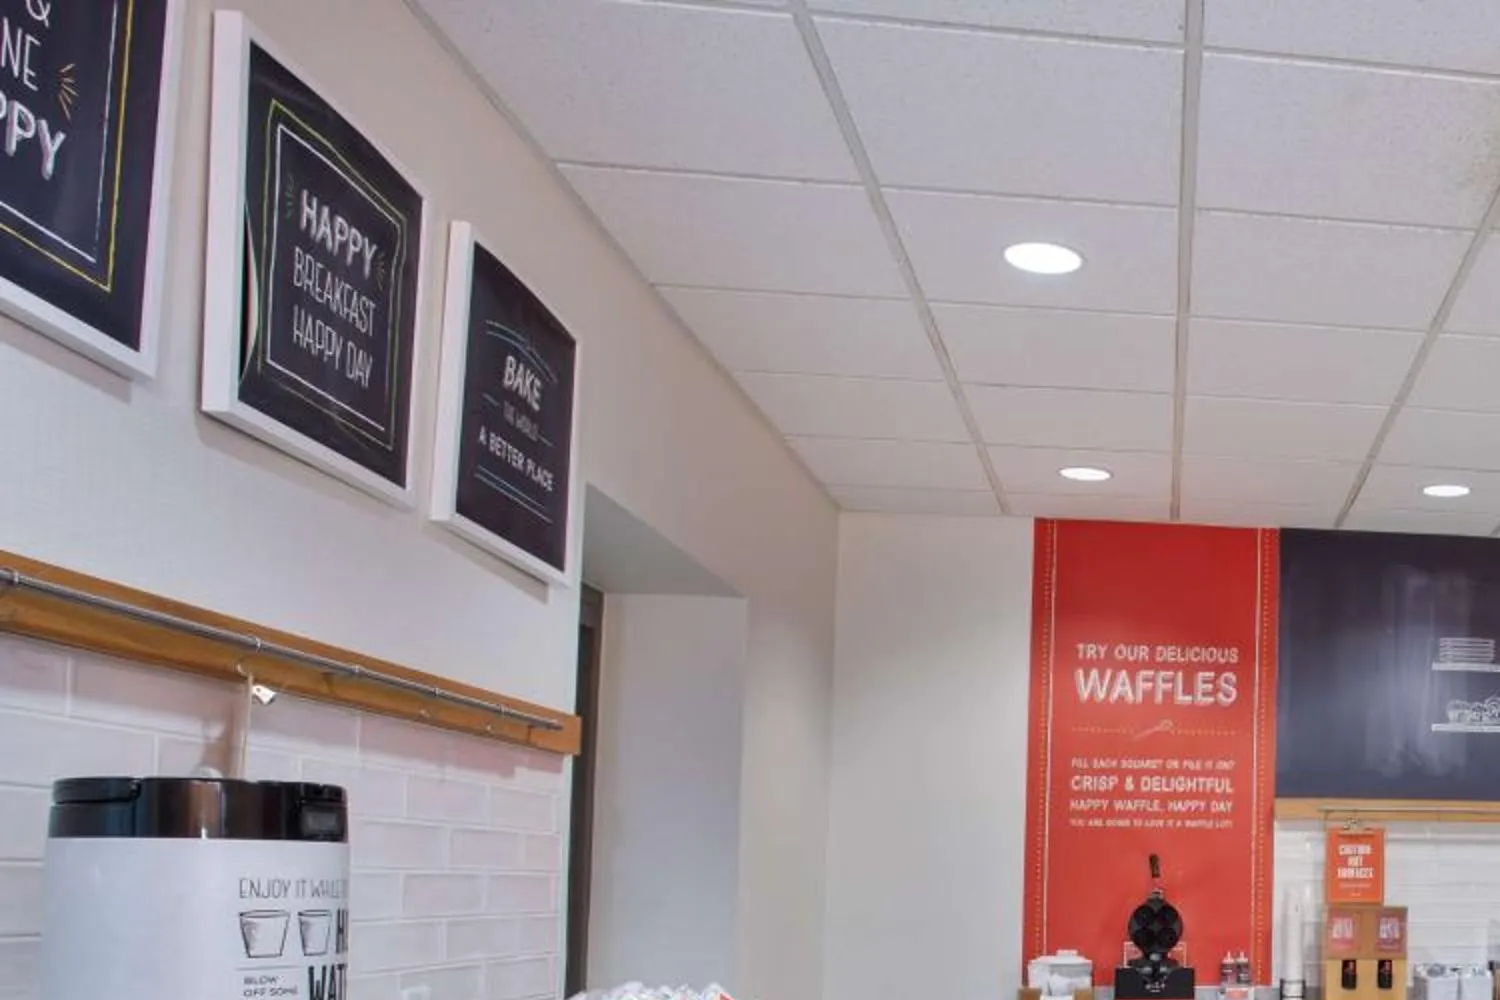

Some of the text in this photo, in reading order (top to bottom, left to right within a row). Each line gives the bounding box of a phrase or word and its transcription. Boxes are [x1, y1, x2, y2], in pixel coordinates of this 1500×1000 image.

[300, 188, 377, 280] HAPPY
[293, 246, 376, 337] BREAKFAST
[293, 304, 373, 388] HAPPY DAY
[503, 355, 542, 412] BAKE
[479, 425, 554, 492] A BETTER PLACE
[1077, 643, 1239, 663] TRY OUR DELICIOUS
[1075, 668, 1238, 705] WAFFLES
[1071, 775, 1234, 793] CRISP & DELIGHTFUL
[1069, 798, 1109, 812] HAPPY
[1168, 800, 1206, 812] HAPPY
[1210, 800, 1233, 813] DAY
[239, 879, 291, 899] ENJOY
[295, 880, 307, 898] IT
[243, 987, 266, 997] OFF
